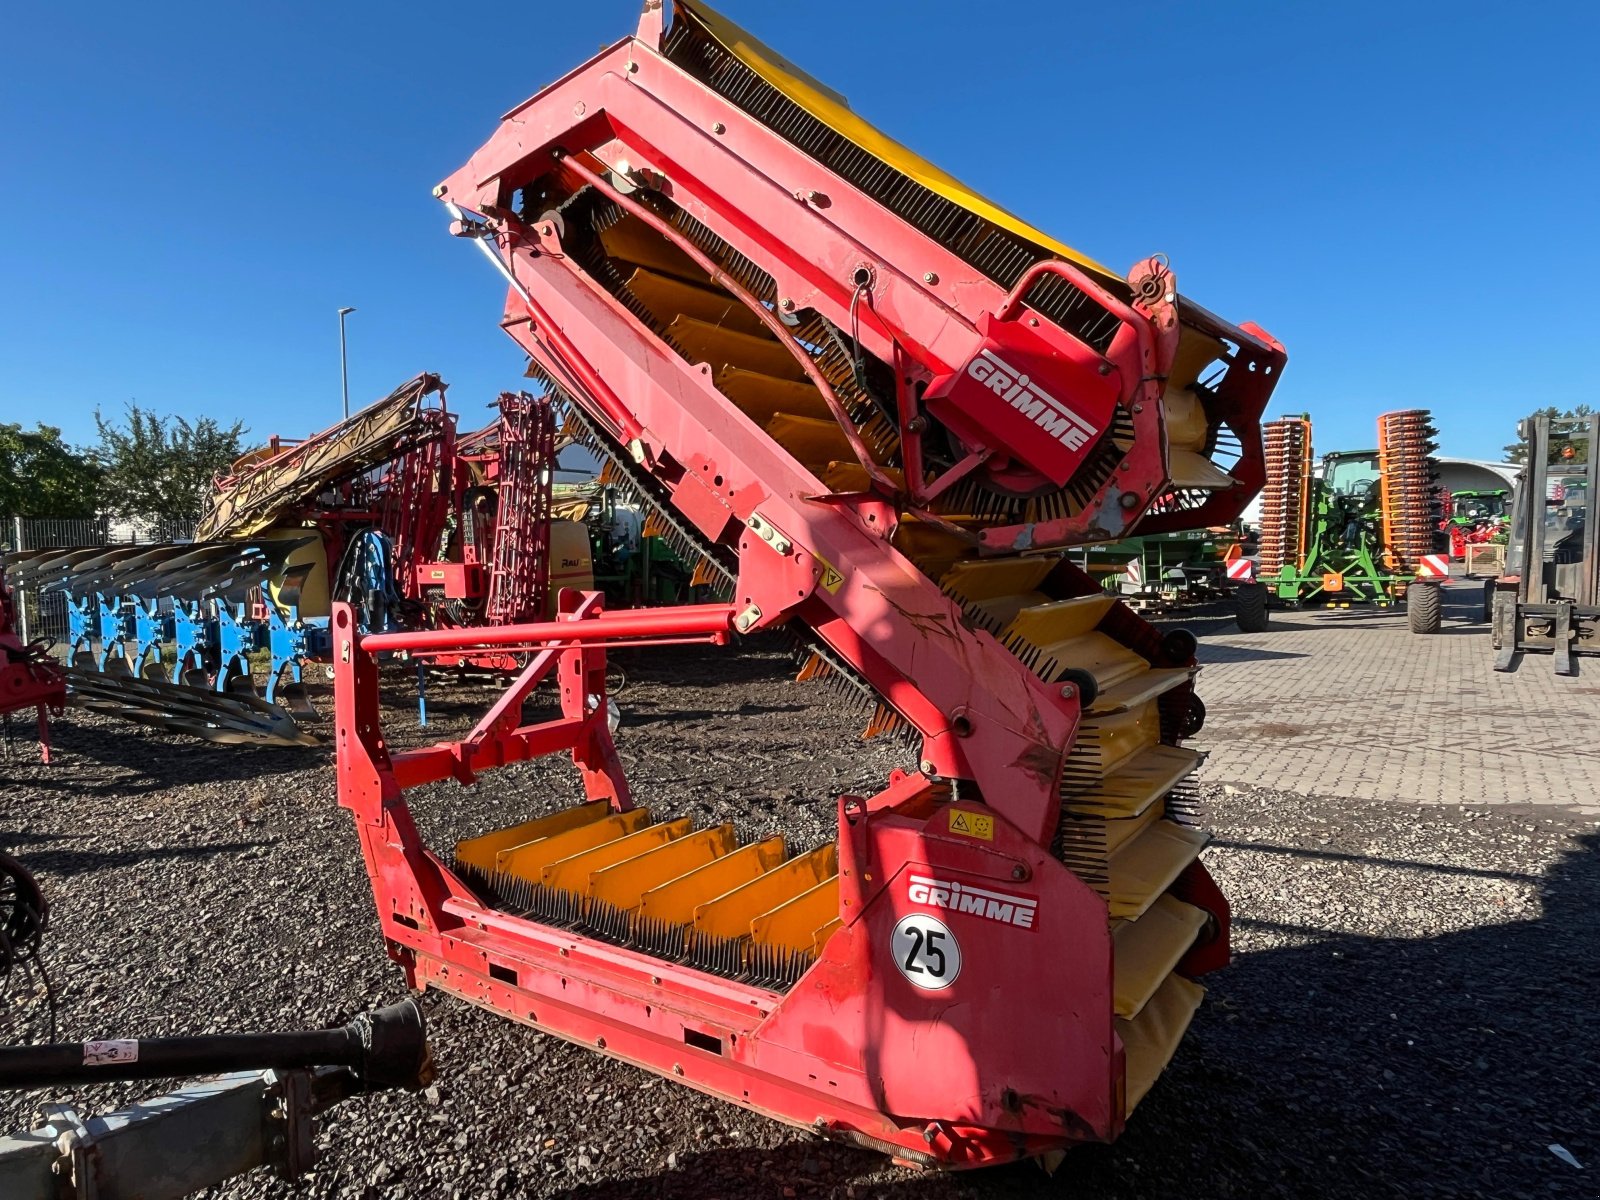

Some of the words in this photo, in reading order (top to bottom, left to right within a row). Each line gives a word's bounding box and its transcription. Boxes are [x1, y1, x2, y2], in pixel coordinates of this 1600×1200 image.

[967, 357, 1091, 453] GRIMME
[908, 881, 1035, 929] GRIMME
[904, 926, 946, 978] 25
